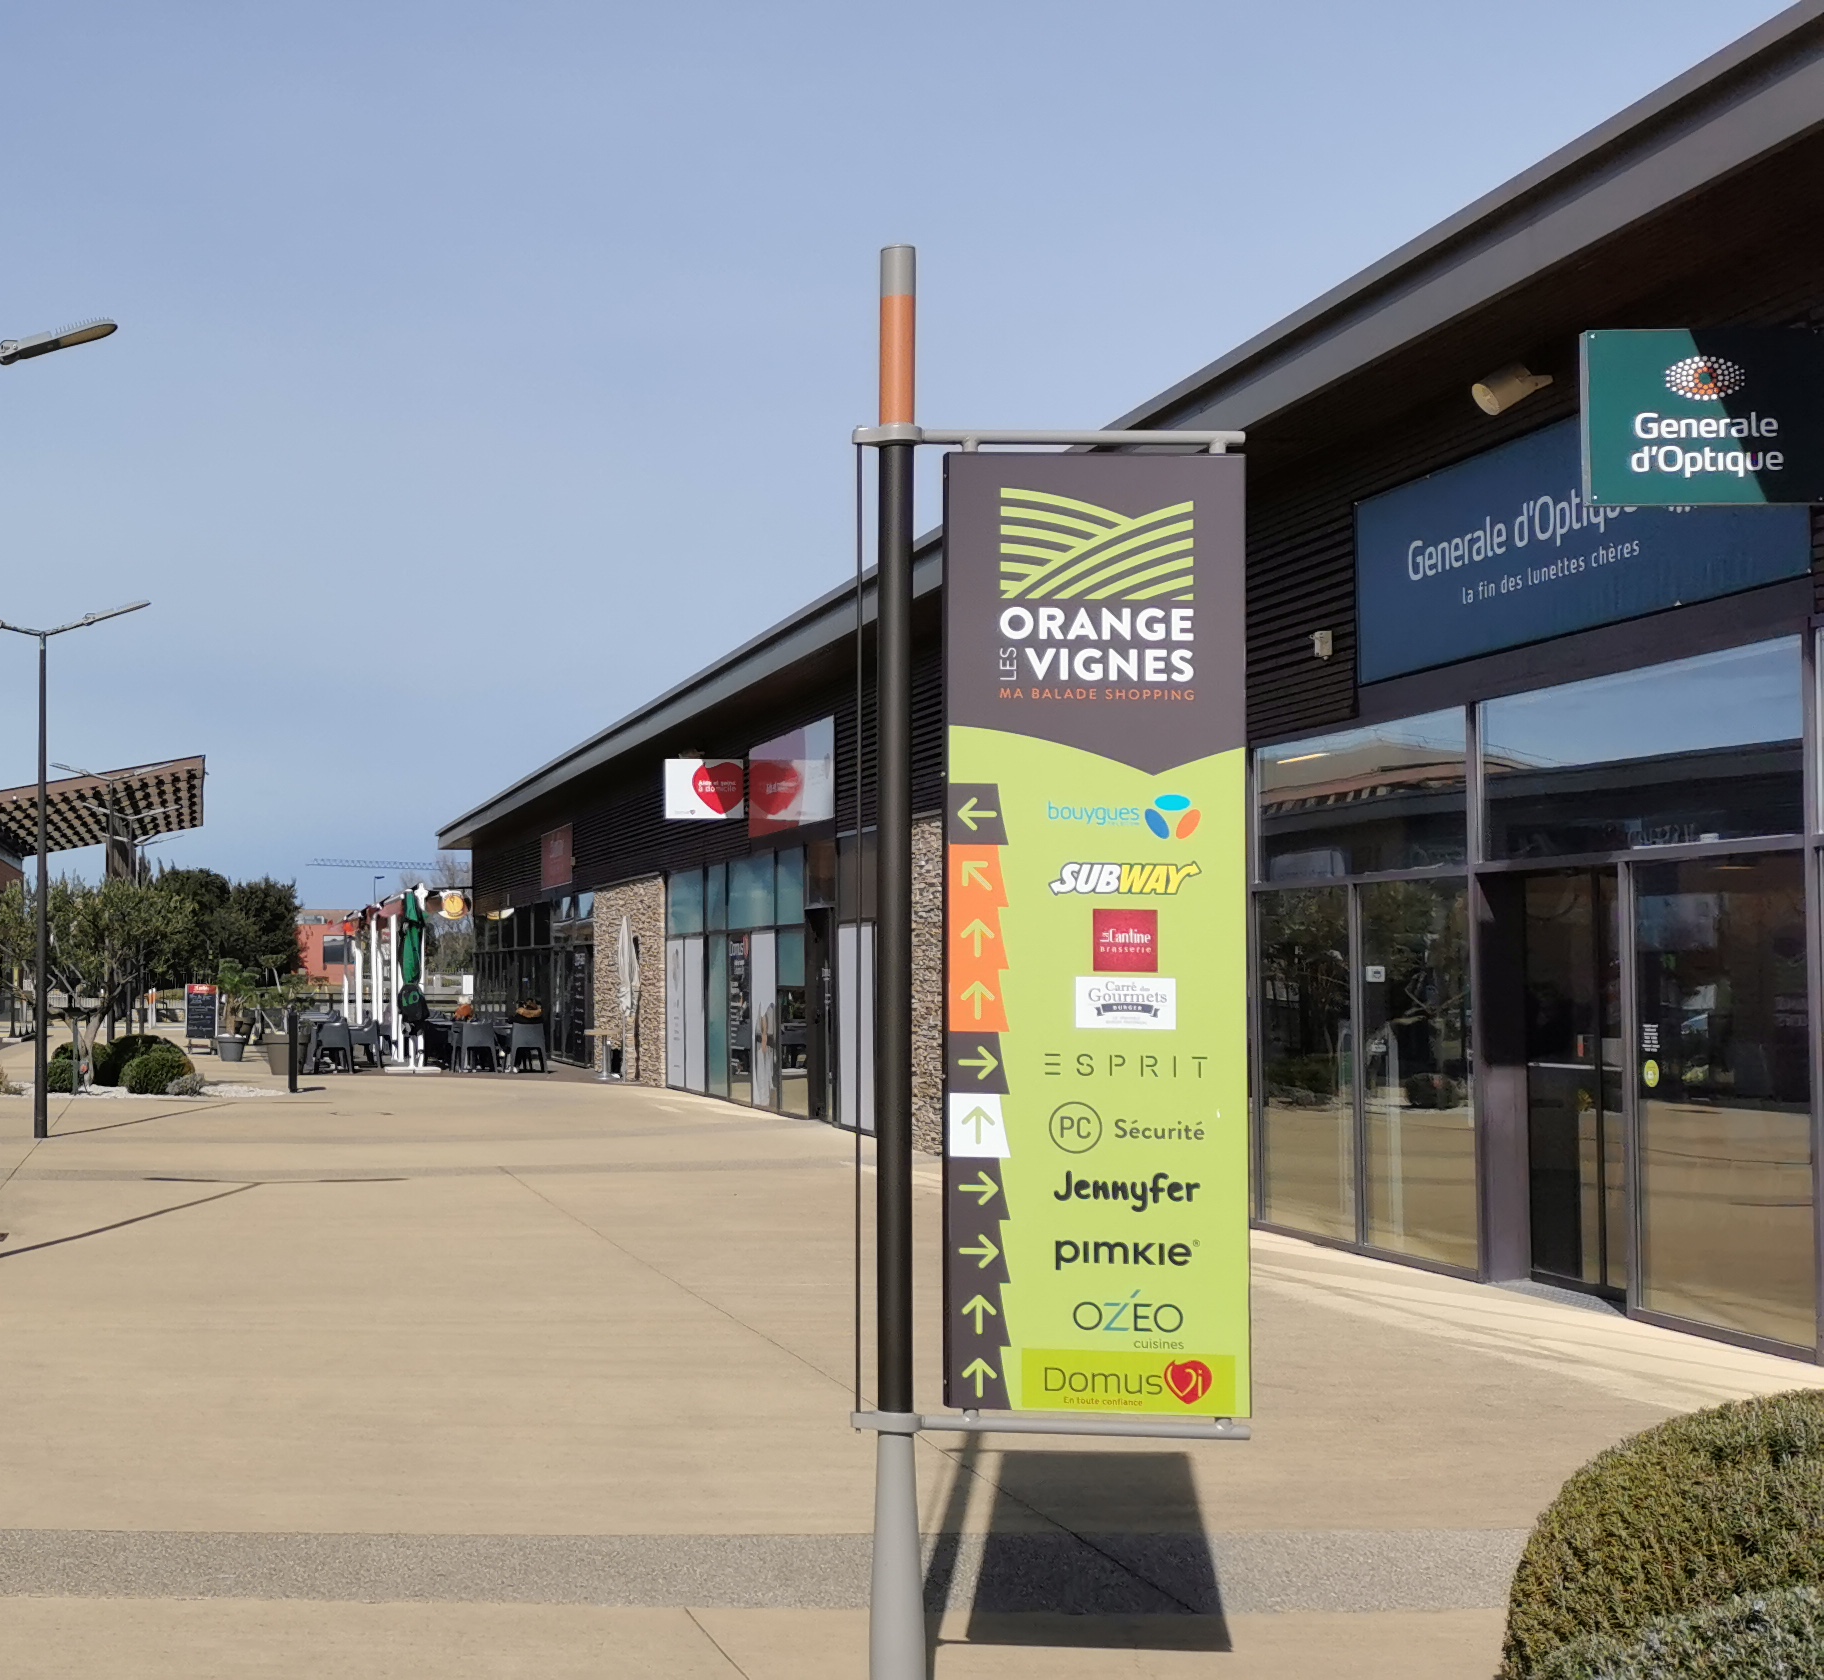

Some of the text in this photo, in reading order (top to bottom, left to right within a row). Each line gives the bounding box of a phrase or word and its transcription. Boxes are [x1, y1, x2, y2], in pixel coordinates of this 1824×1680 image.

[1635, 412, 1779, 439] Generale
[1631, 446, 1784, 478] d'Optique
[1408, 488, 1637, 580] Generale d'Optiq
[1462, 539, 1641, 604] la fin des lunettes chères
[999, 606, 1194, 641] ORANGE
[999, 647, 1017, 681] LES
[1024, 647, 1194, 682] VIGNES
[999, 687, 1195, 701] MA BALADE SHOPPING
[1048, 801, 1140, 826] bouygues
[1048, 861, 1202, 896] SUBWAY
[1109, 928, 1152, 944] Cantine
[1100, 945, 1152, 954] Brasserie
[1088, 987, 1168, 1004] Gourmets
[1105, 980, 1137, 992] Carré
[1044, 1053, 1208, 1078] ESPRIT
[1060, 1115, 1205, 1140] PC Sécurité
[1053, 1170, 1201, 1212] Jennyfer
[1133, 1338, 1185, 1350] cuisines
[1063, 1396, 1143, 1407] En toute confiance
